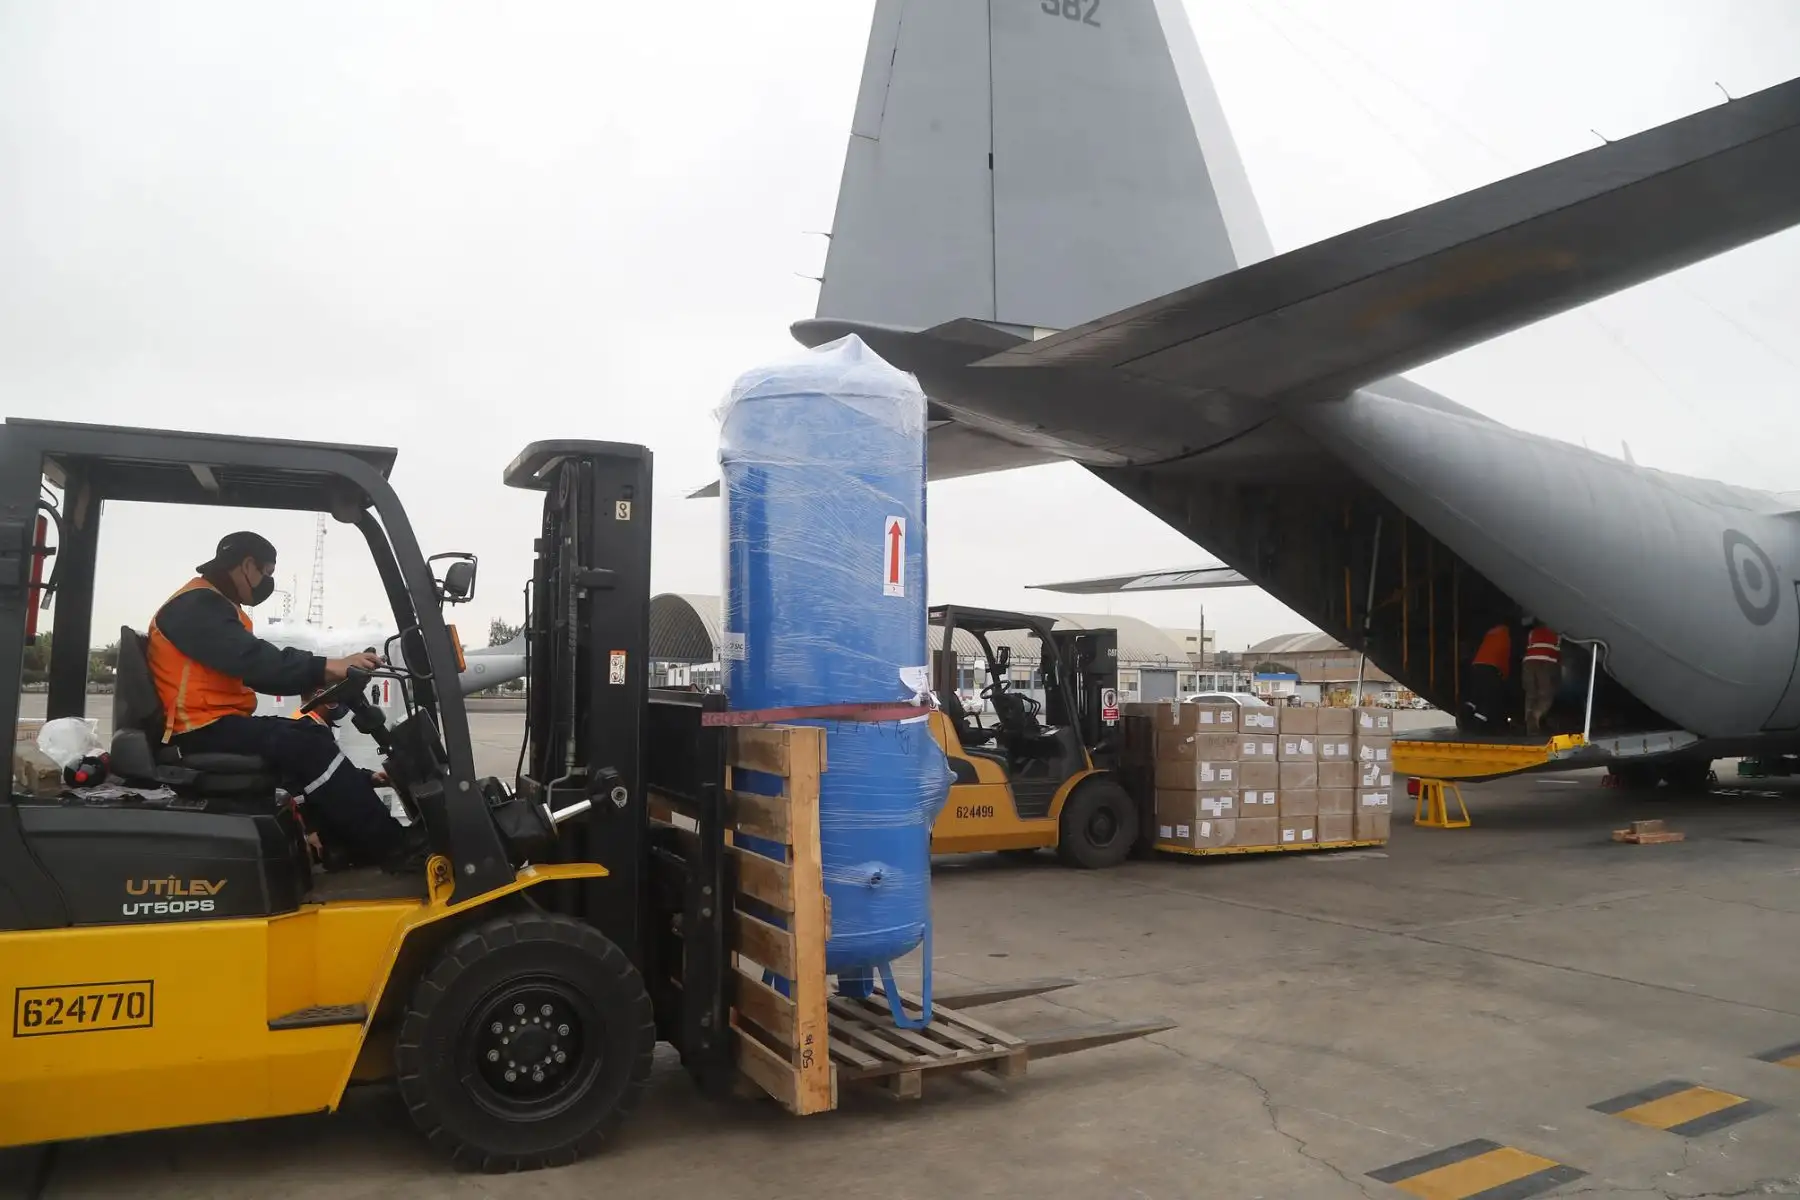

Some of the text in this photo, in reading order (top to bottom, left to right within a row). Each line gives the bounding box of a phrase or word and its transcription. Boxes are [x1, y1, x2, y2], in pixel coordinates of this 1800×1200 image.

[956, 805, 994, 819] 624499
[126, 877, 228, 897] UTILEV
[122, 899, 215, 916] UT50PS
[23, 991, 145, 1027] 624770
